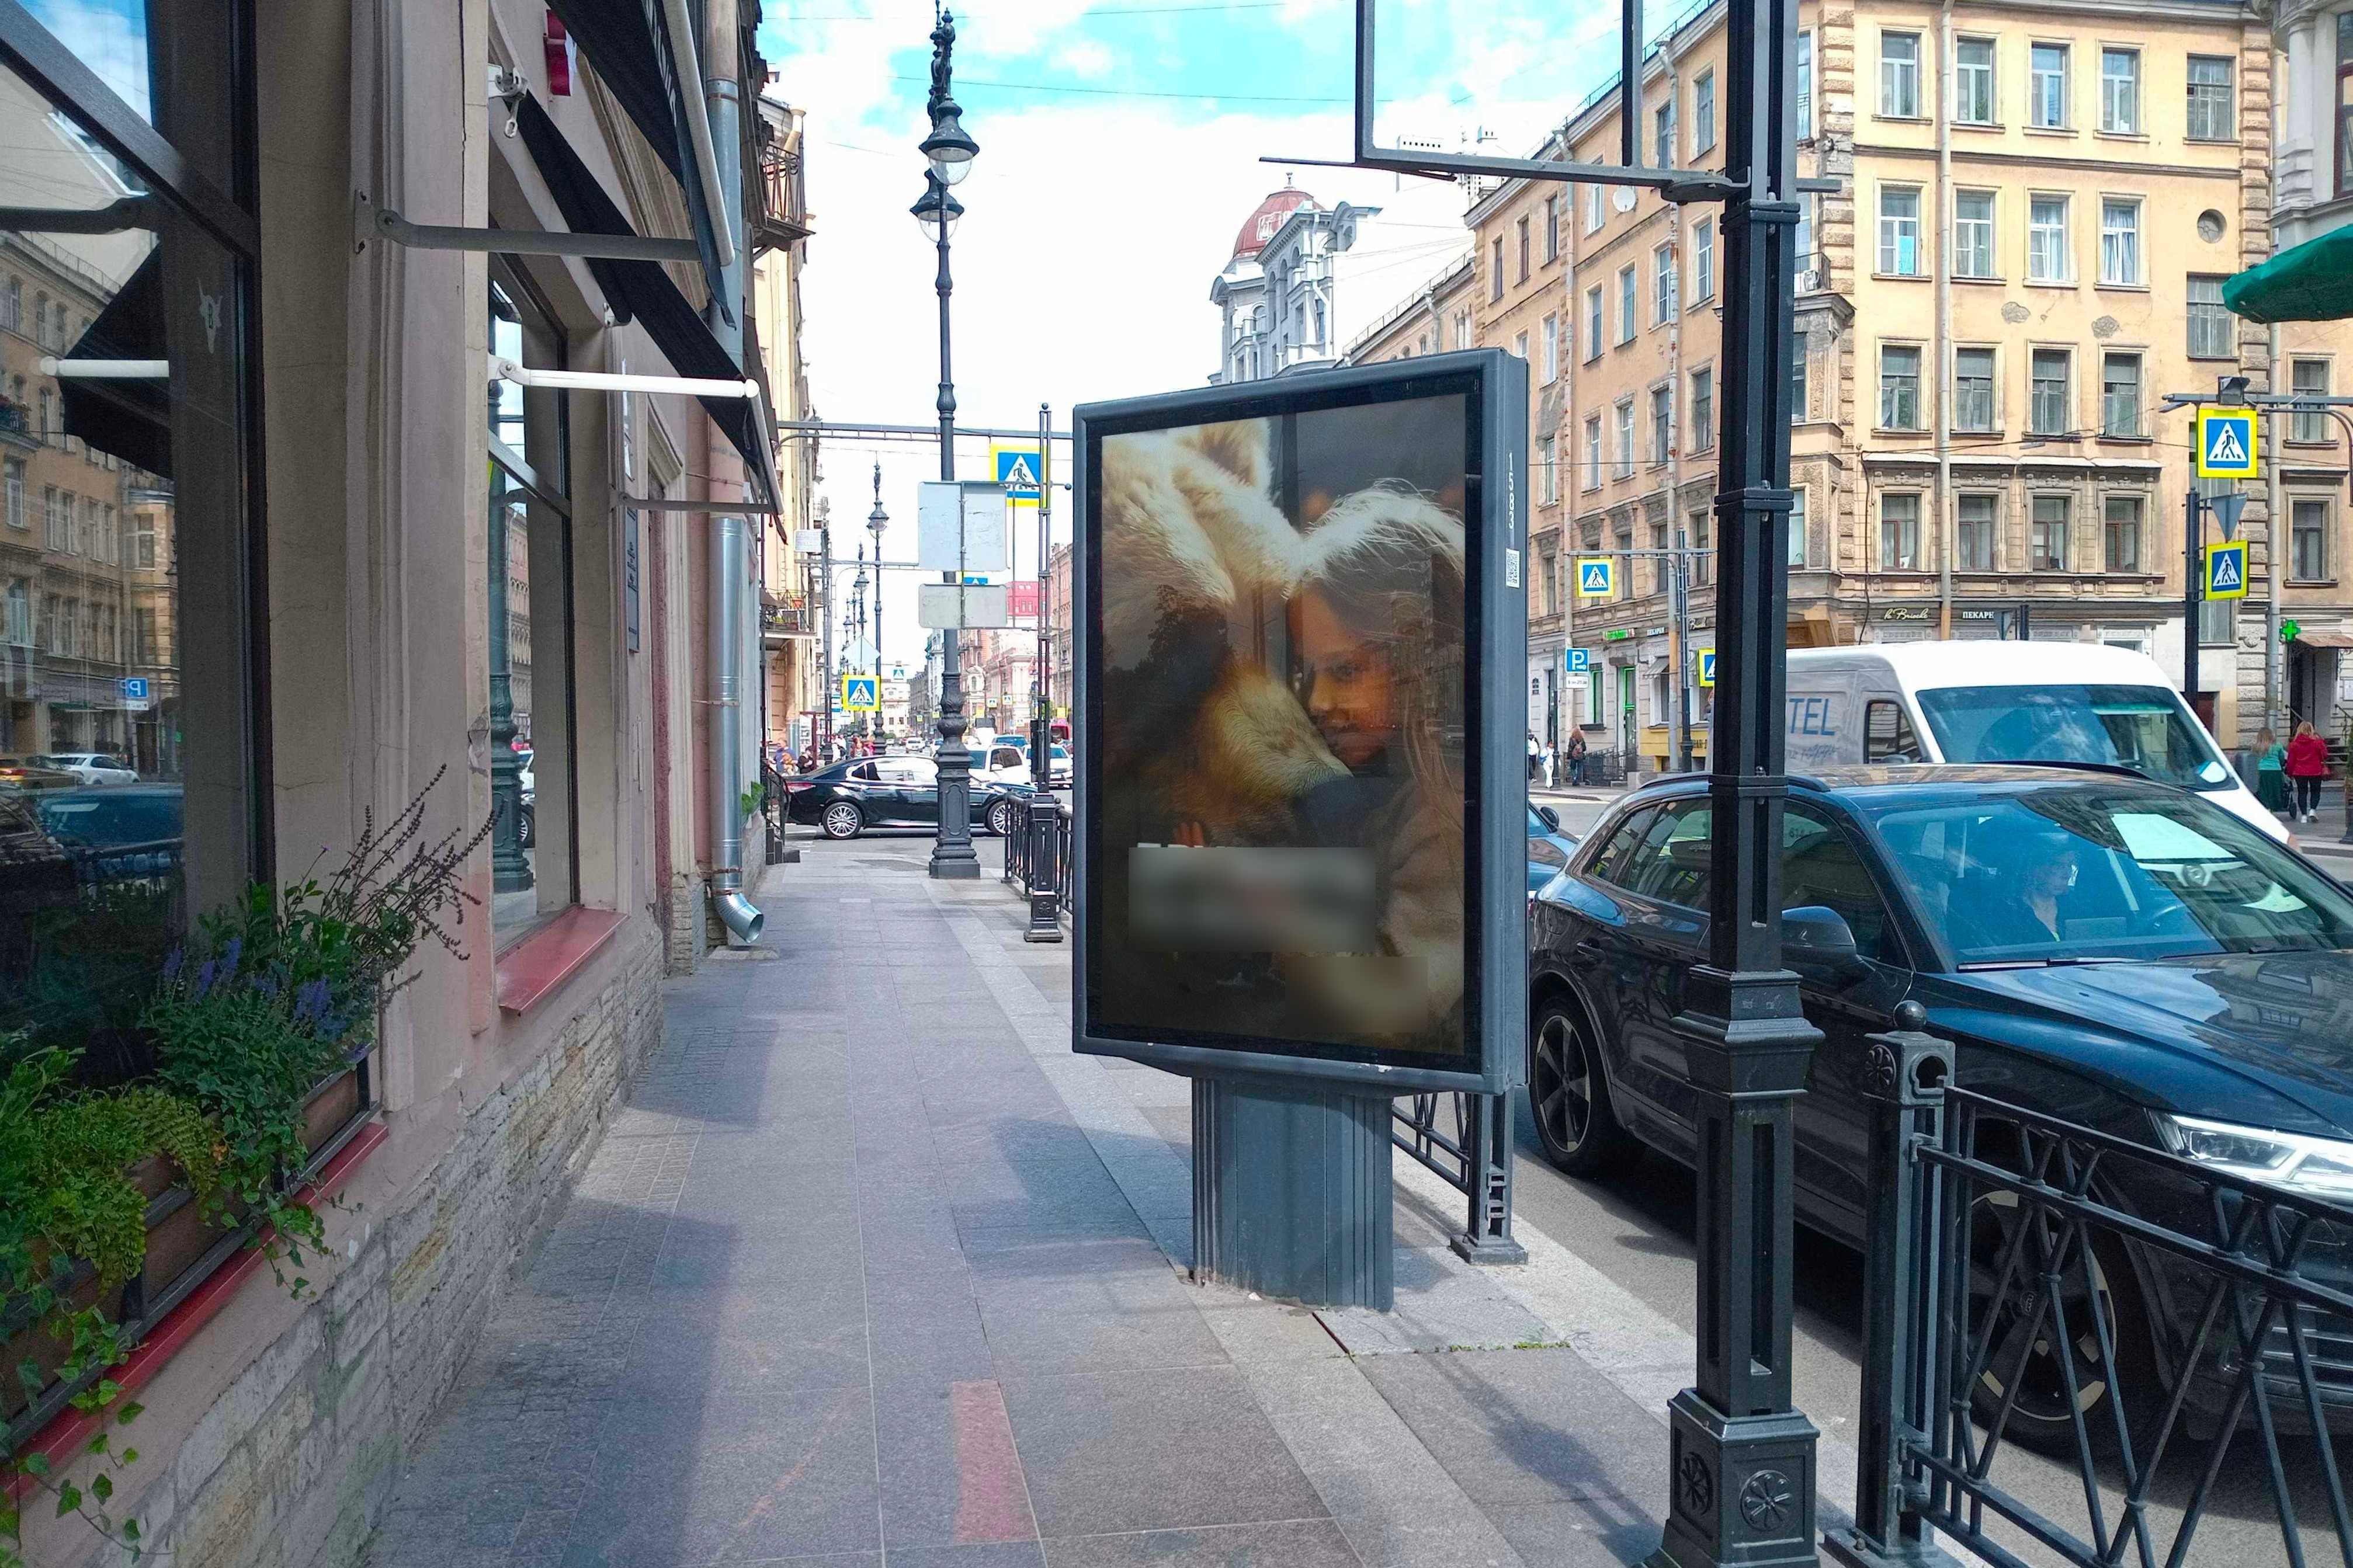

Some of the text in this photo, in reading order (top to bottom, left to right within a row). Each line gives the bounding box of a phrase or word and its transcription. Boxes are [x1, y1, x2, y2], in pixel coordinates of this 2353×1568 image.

[1962, 611, 1995, 619] ПЕКАРН
[1571, 651, 1585, 670] P
[1788, 698, 1837, 736] TEL
